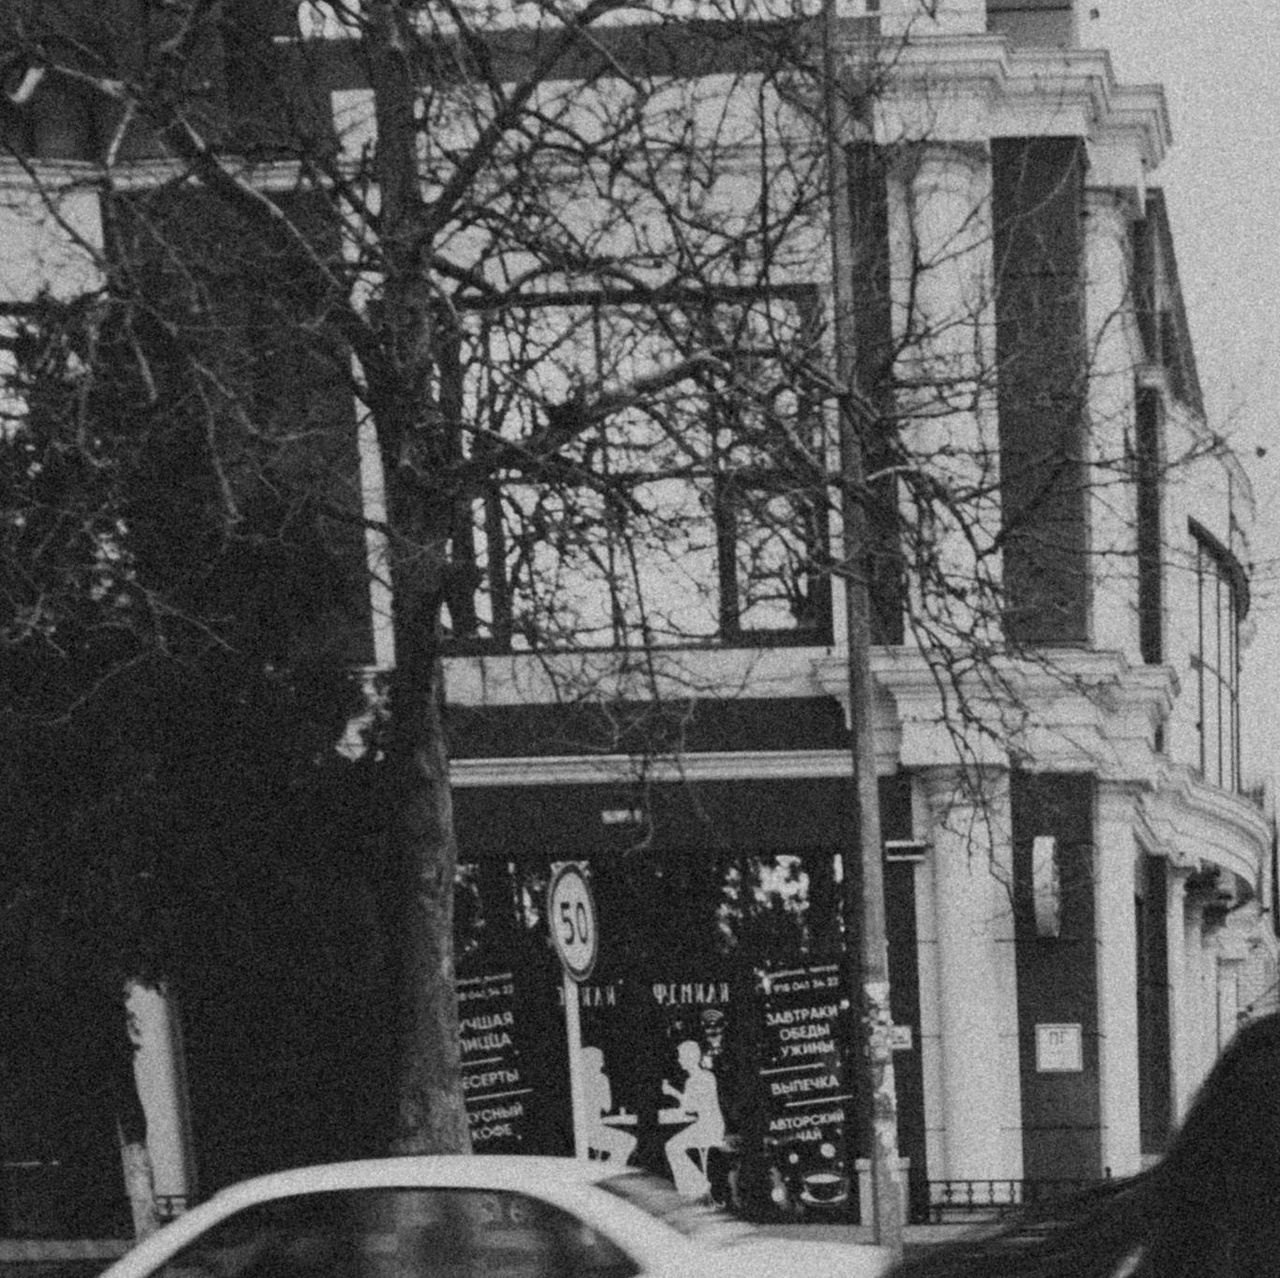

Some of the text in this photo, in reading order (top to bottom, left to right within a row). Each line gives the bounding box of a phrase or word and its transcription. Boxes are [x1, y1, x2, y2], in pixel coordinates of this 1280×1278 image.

[559, 901, 588, 946] 50
[459, 1011, 515, 1031] УЧШАЯ
[766, 1005, 838, 1026] ЗАВТРАКИ
[779, 1022, 831, 1041] ОБЕДЫ
[780, 1039, 835, 1059] УЖИНЫ
[462, 1068, 520, 1090] ЕСЕРТЫ
[770, 1074, 841, 1096] ВЫПЕЧКА
[468, 1101, 524, 1123] УСНЫЙ
[769, 1108, 846, 1132] АВТОРСКИЙ
[471, 1123, 513, 1141] КОФЕ
[795, 1126, 823, 1142] ЧАЙ
